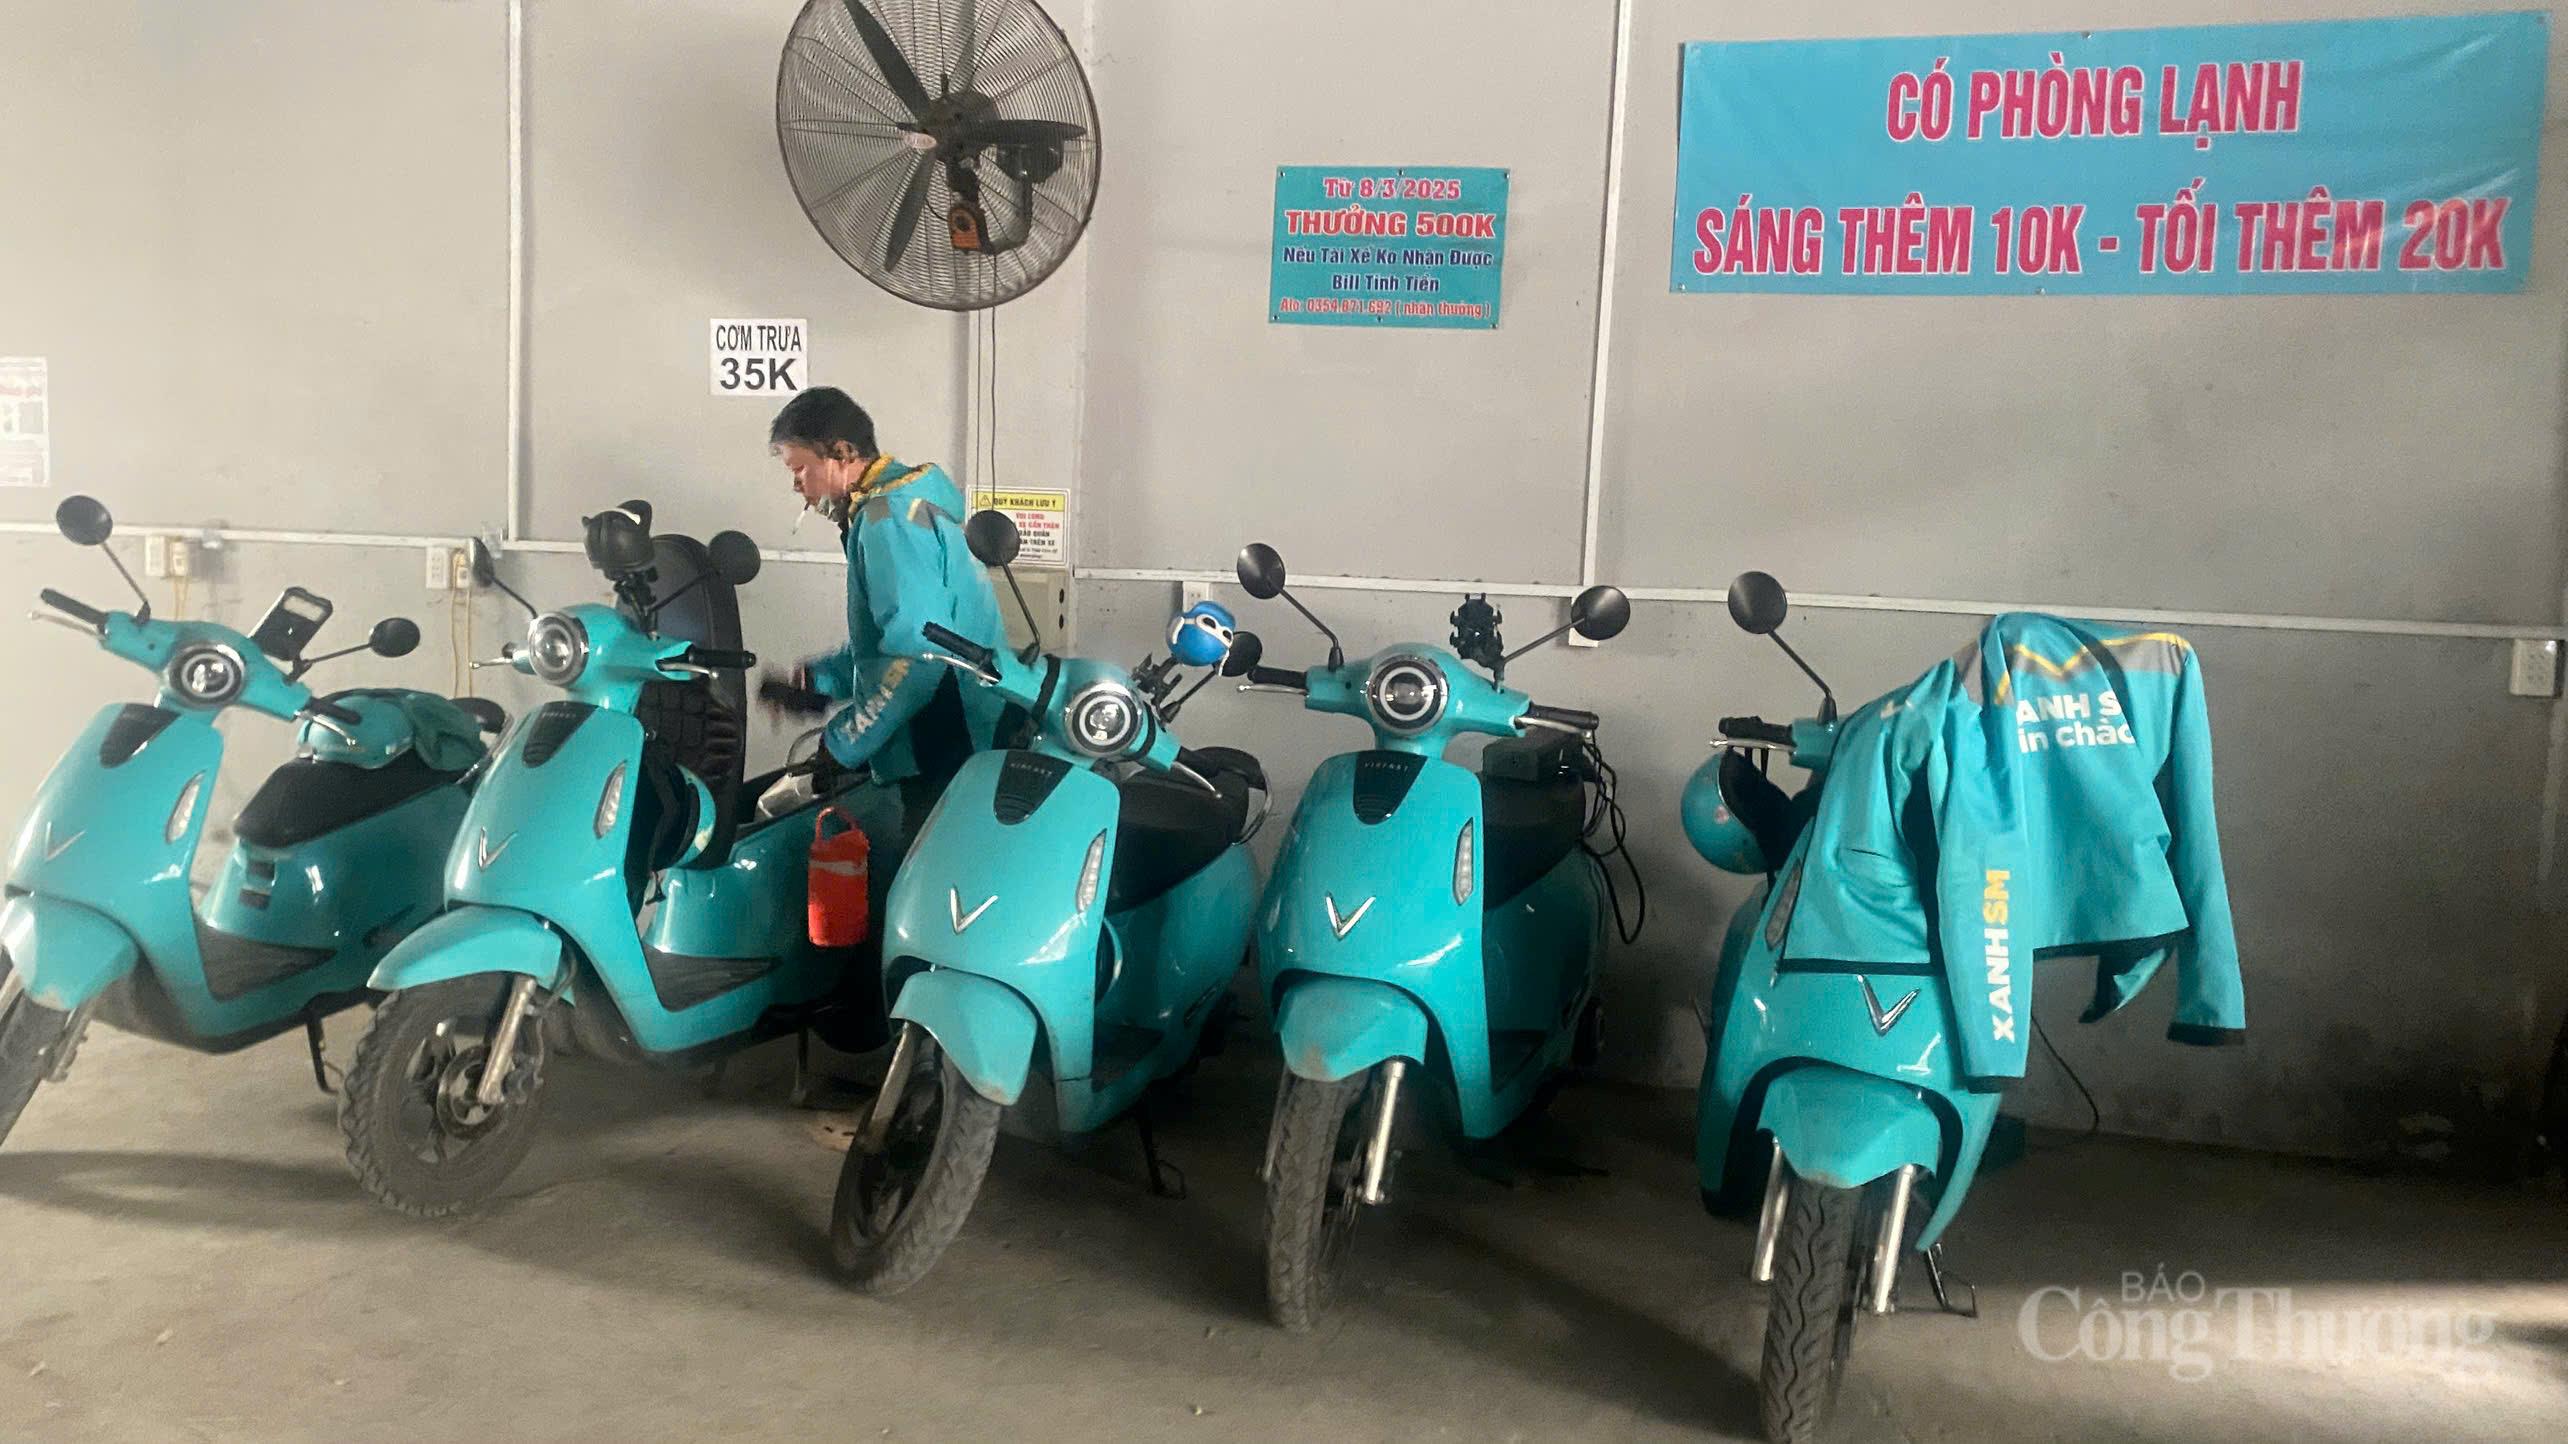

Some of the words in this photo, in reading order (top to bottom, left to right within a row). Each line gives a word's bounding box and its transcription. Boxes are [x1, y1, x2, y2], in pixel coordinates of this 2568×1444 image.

[1887, 57, 1953, 142] CÓ
[1966, 51, 2144, 140] PHÒNG
[2158, 60, 2303, 150] LẠNH
[1359, 177, 1461, 200] 8/3/2025
[1285, 203, 1408, 237] THƯỞNG
[1415, 211, 1496, 239] 500K
[1692, 194, 1825, 276] SÁNG
[1838, 192, 1974, 276] THÊM
[1991, 204, 2085, 276] 10K
[2136, 177, 2218, 275] TỐI
[2234, 185, 2387, 273] THÊM
[2397, 196, 2512, 272] 20K
[1376, 247, 1397, 266] Ko
[1448, 248, 1493, 270] Được
[1332, 273, 1360, 292] Bill
[716, 325, 752, 351] CƠM
[757, 325, 802, 352] TRƯA
[720, 357, 798, 391] 35K
[2016, 692, 2091, 725] ANH
[2098, 690, 2122, 716] S
[2017, 727, 2048, 754] in
